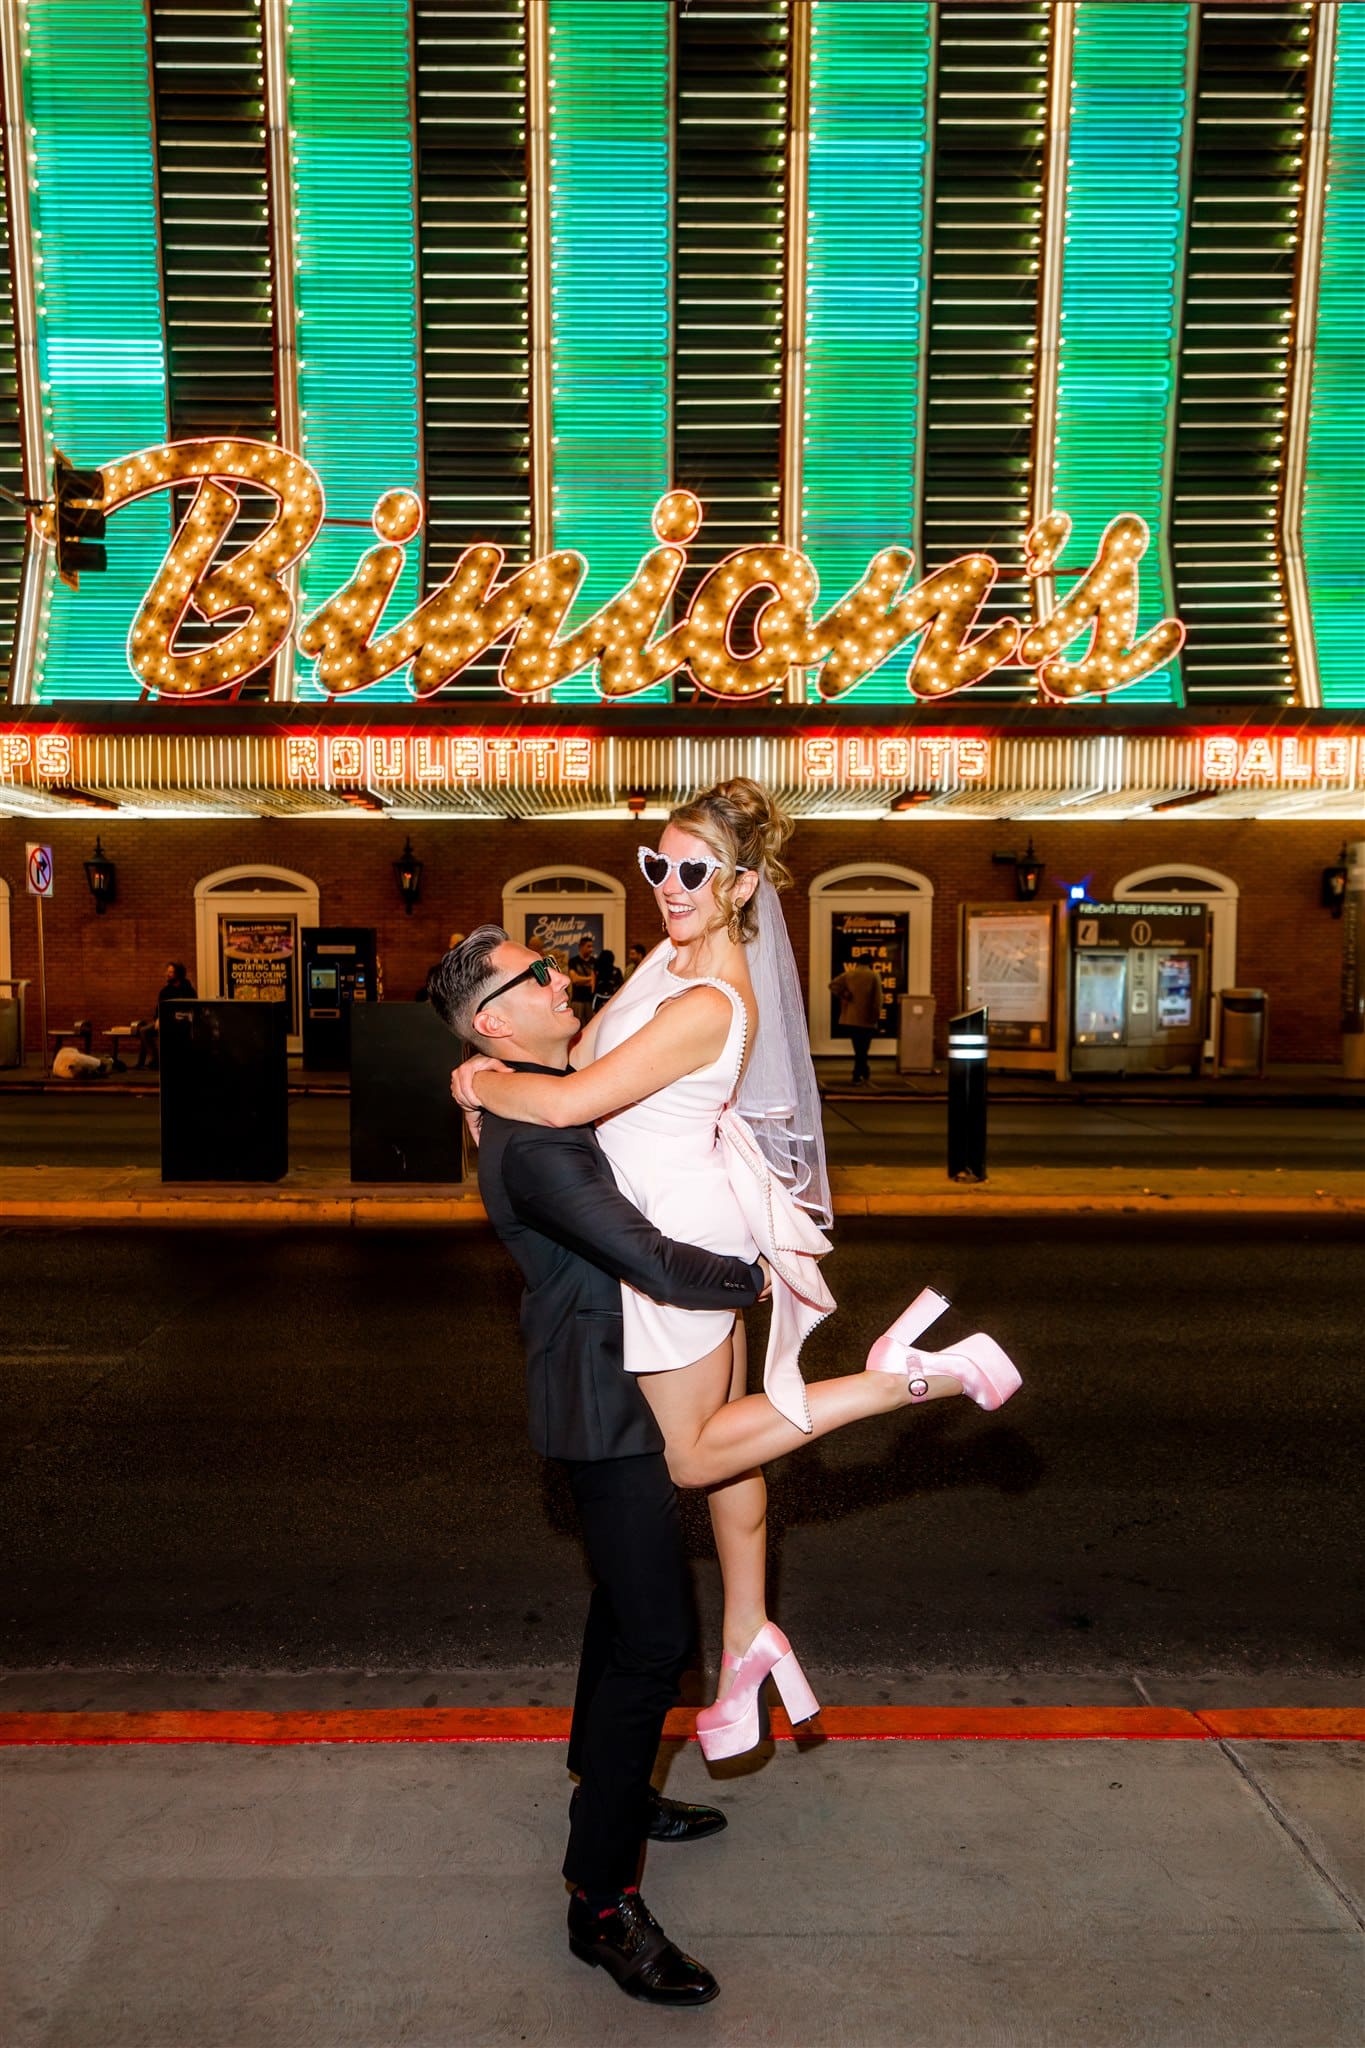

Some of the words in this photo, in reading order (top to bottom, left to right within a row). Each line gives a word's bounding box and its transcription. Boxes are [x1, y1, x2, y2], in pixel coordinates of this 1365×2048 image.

[31, 436, 1186, 699] Binion's
[287, 736, 592, 780] ROULETTE
[804, 737, 990, 780] SLOTS
[1203, 737, 1365, 781] SALO
[533, 916, 576, 937] Salud
[878, 946, 888, 958] &
[231, 971, 287, 979] OVERLOOKING
[232, 963, 269, 971] ROTATING
[271, 963, 286, 971] BAR
[843, 962, 892, 973] WCH
